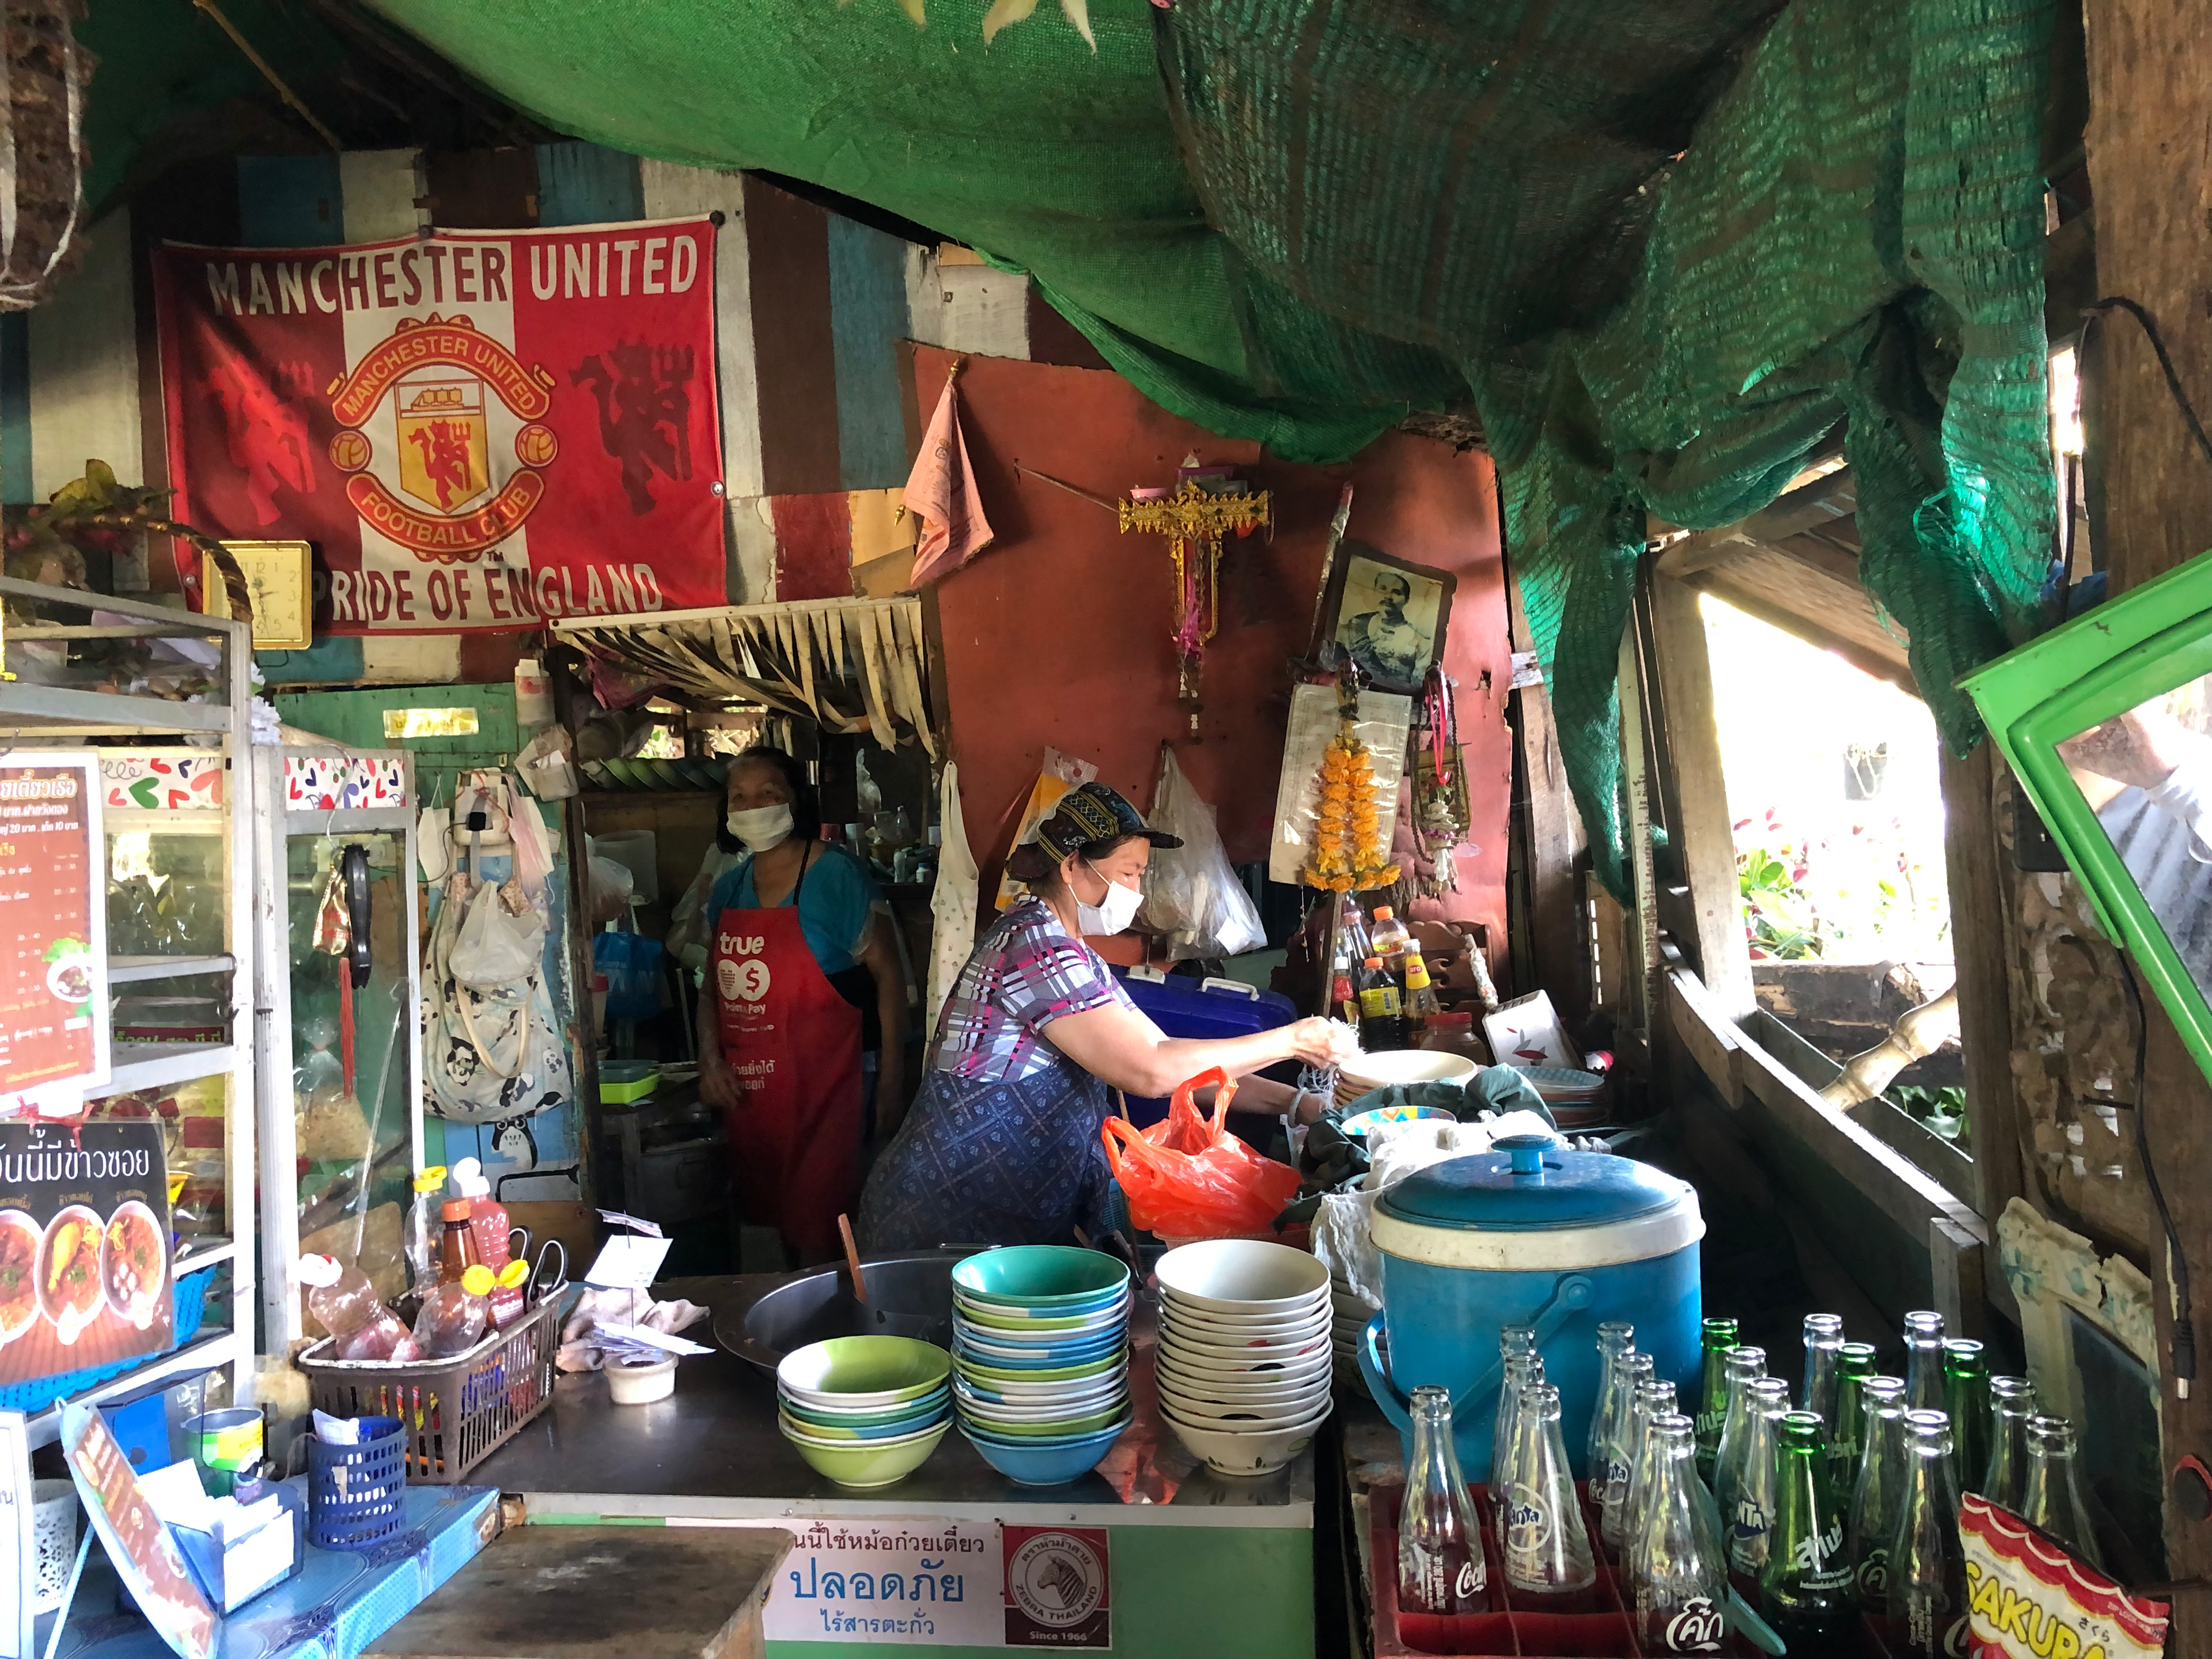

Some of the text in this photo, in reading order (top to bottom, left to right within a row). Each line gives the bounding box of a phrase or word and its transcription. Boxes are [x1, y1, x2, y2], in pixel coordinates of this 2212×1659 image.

[206, 235, 698, 315] MANCHESTER UNITED
[342, 335, 536, 416] MANCHESTER UNITED
[362, 487, 531, 545] FOOTBALL CLUB
[312, 563, 662, 622] PRIDE OF ENGLAND
[10, 823, 20, 834] 20
[55, 821, 63, 831] 10
[719, 931, 765, 955] true
[748, 1003, 766, 1015] Pay
[790, 1556, 964, 1603] ปลอดภัย
[1016, 1582, 1097, 1621] ZEBRA THAILAND
[819, 1607, 935, 1635] ไร้สารตะกั่ว
[1029, 1630, 1088, 1641] Since 1966
[2078, 1616, 2111, 1643] さくら
